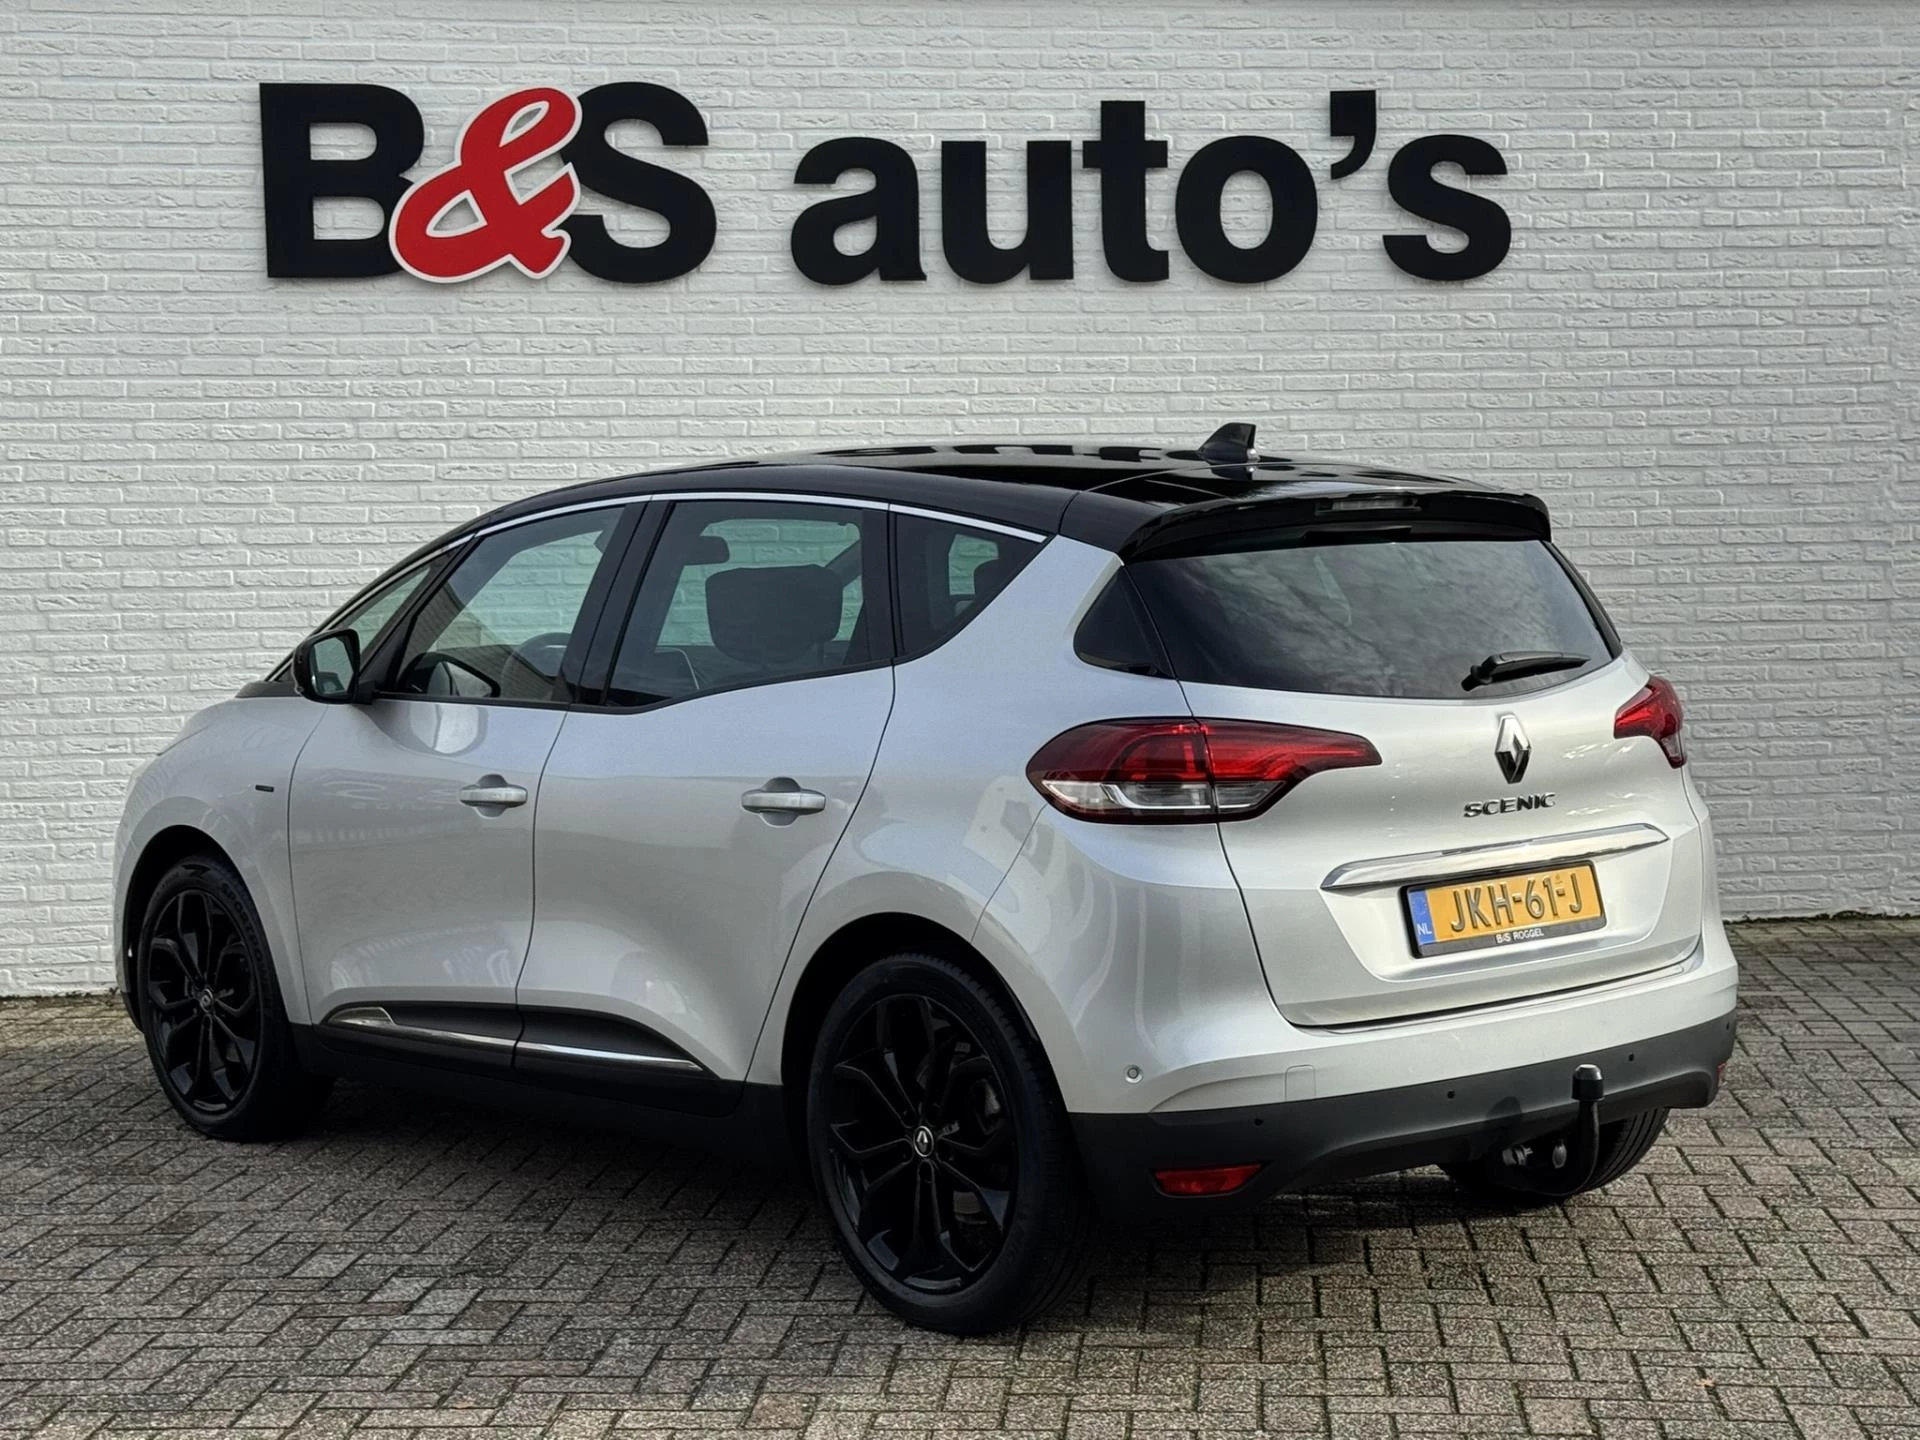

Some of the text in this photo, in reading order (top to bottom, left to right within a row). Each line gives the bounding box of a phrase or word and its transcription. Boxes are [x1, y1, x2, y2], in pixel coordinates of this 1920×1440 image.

[259, 81, 717, 284] B&S
[1464, 792, 1556, 818] SCENIC
[1451, 873, 1583, 932] JKH-61-J
[1417, 923, 1433, 936] NL
[1512, 927, 1545, 941] ROGGEL
